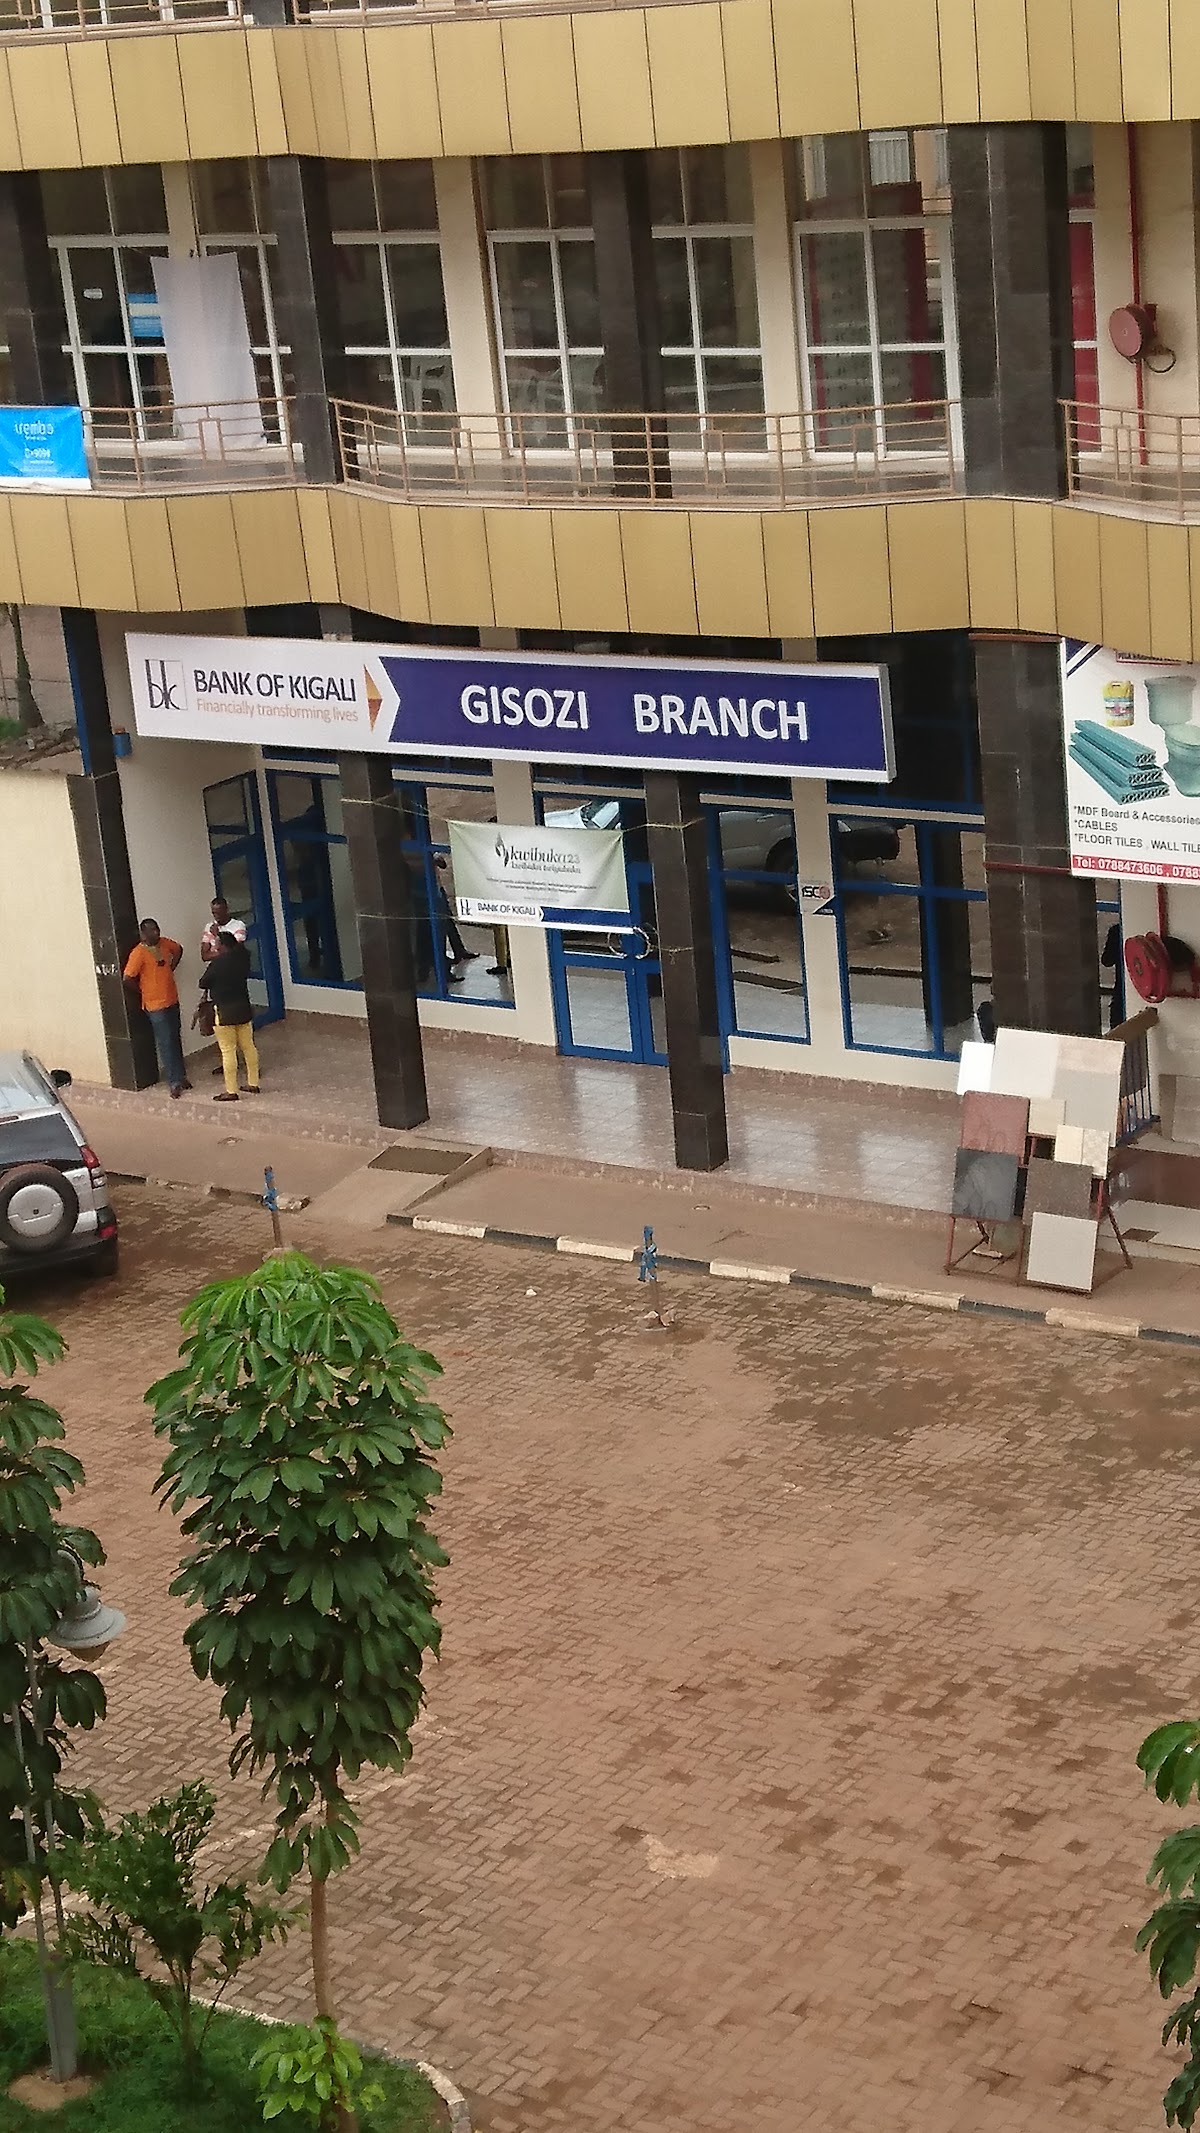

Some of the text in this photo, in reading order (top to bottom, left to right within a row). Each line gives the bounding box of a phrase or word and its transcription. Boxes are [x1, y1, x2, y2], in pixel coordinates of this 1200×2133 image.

[194, 669, 356, 702] BANK OF KIGALI
[197, 699, 359, 723] Financially transforming lives
[461, 684, 808, 741] GISOZI BRANCH
[1101, 808, 1130, 819] Board
[1132, 810, 1139, 820] &
[1141, 812, 1200, 825] Accessories
[1115, 837, 1143, 848] TILES
[1151, 840, 1179, 852] WALL
[1076, 857, 1095, 869] Tel:
[1098, 859, 1163, 875] 0788473606
[477, 902, 535, 916] BANK OF KIGALI
